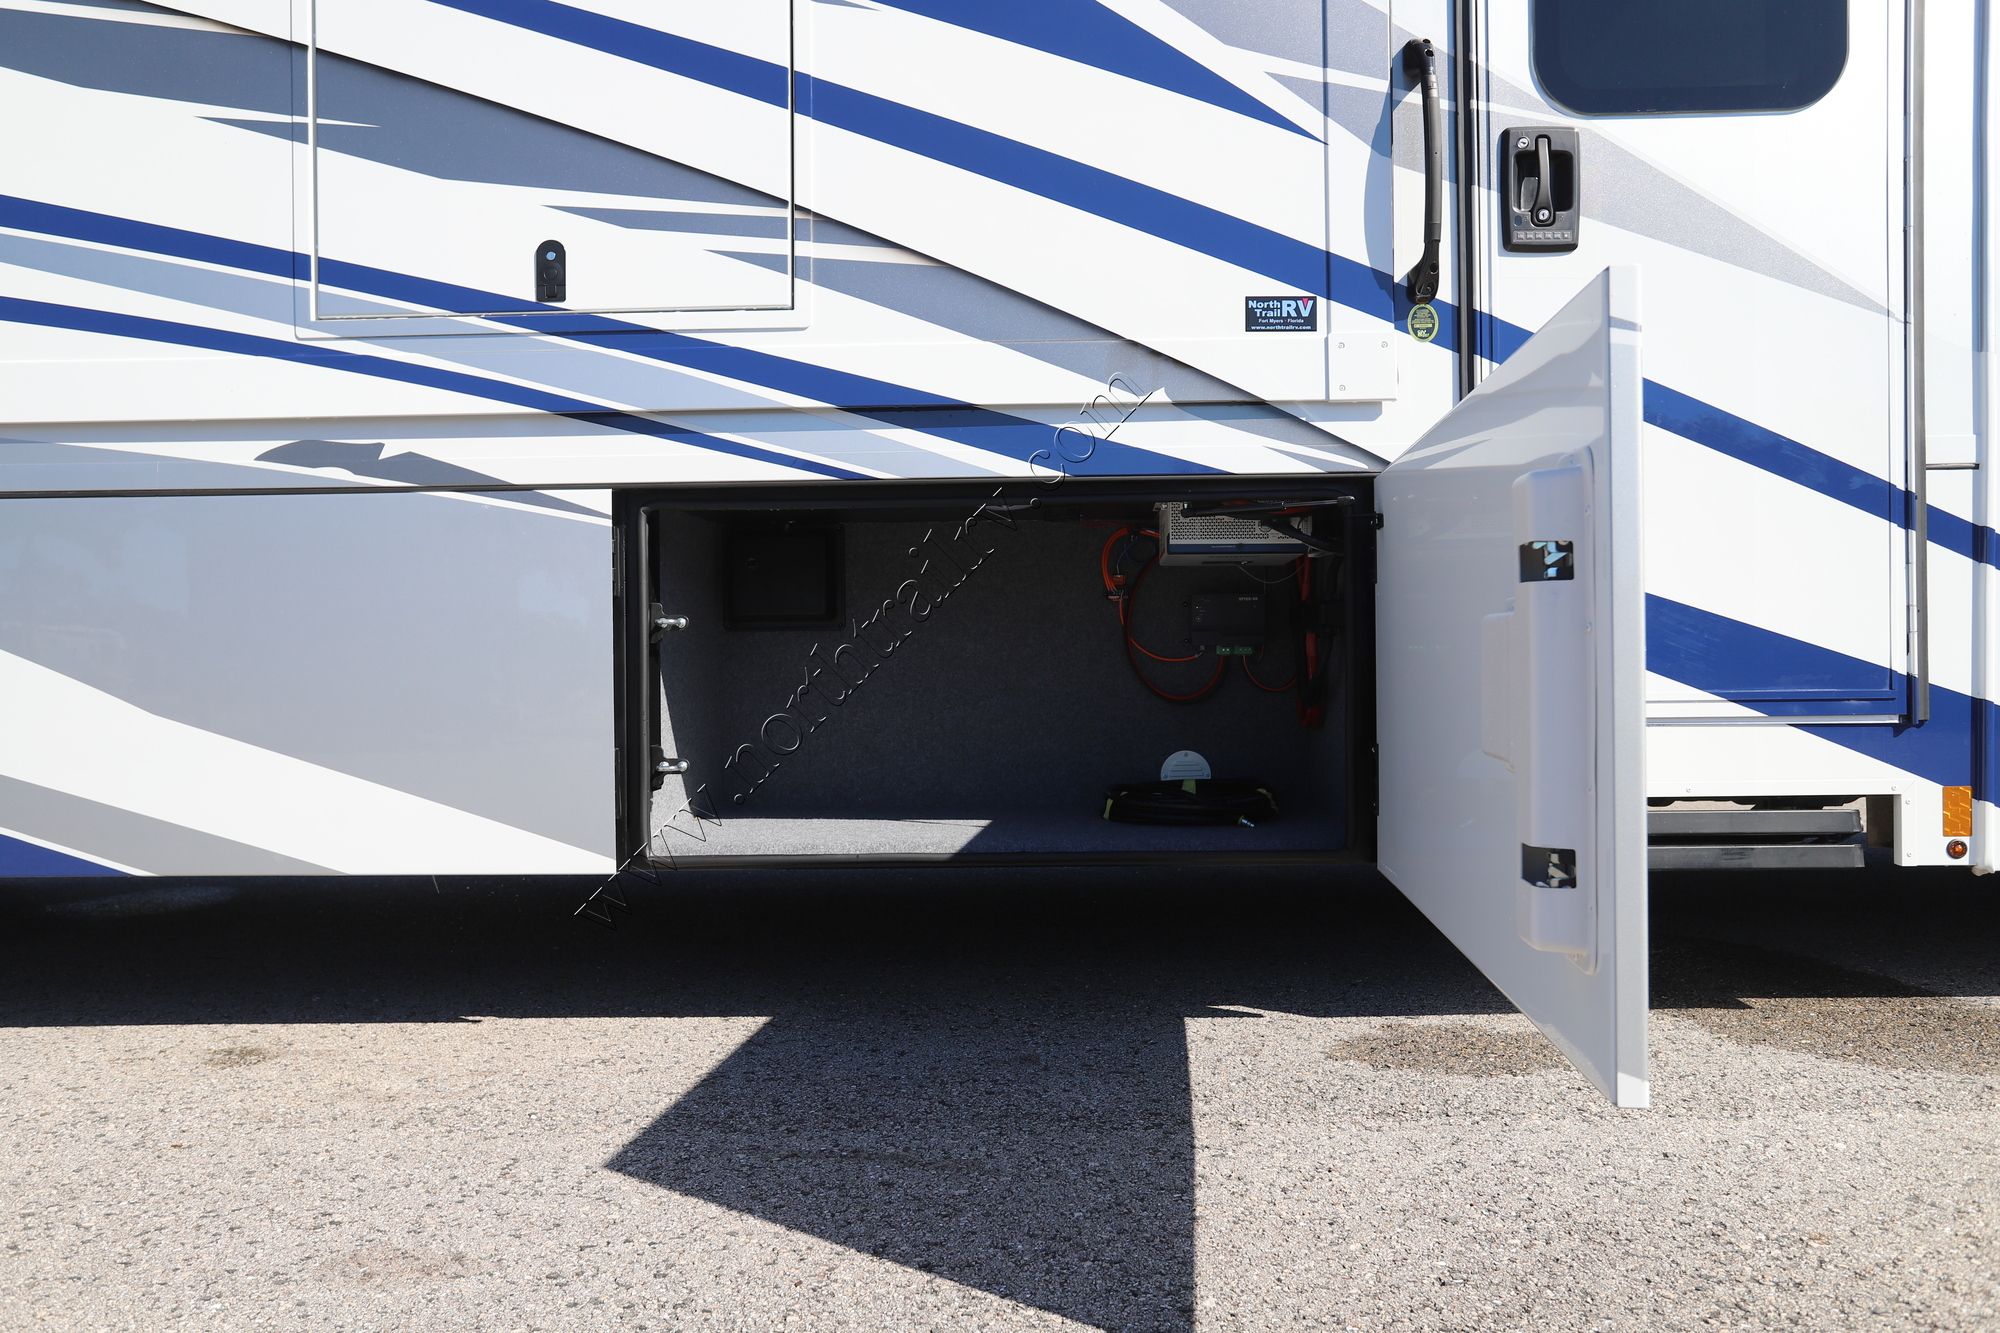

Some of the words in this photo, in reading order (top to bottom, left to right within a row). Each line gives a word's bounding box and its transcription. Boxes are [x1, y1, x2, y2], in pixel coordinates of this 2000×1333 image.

[1248, 300, 1281, 309] North
[1281, 299, 1314, 317] RV
[1254, 308, 1281, 317] Trail
